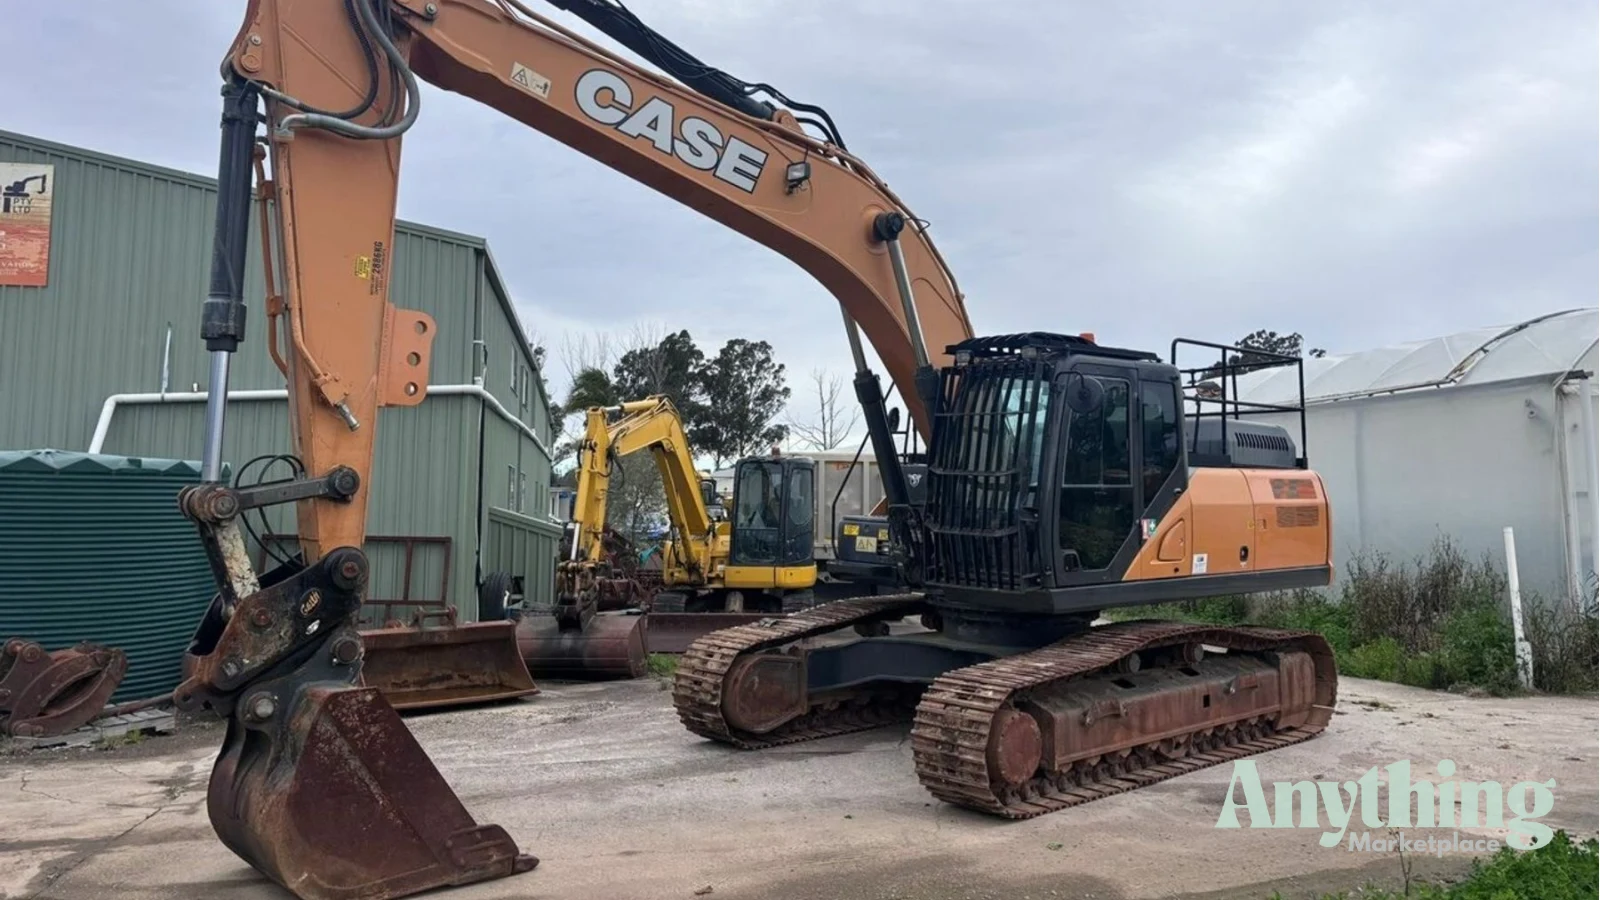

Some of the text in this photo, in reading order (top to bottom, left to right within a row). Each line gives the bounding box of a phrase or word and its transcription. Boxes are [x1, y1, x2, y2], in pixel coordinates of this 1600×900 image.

[574, 68, 769, 194] CASE
[12, 205, 31, 214] LTD
[13, 197, 33, 205] PTY
[372, 241, 383, 274] 2886KG
